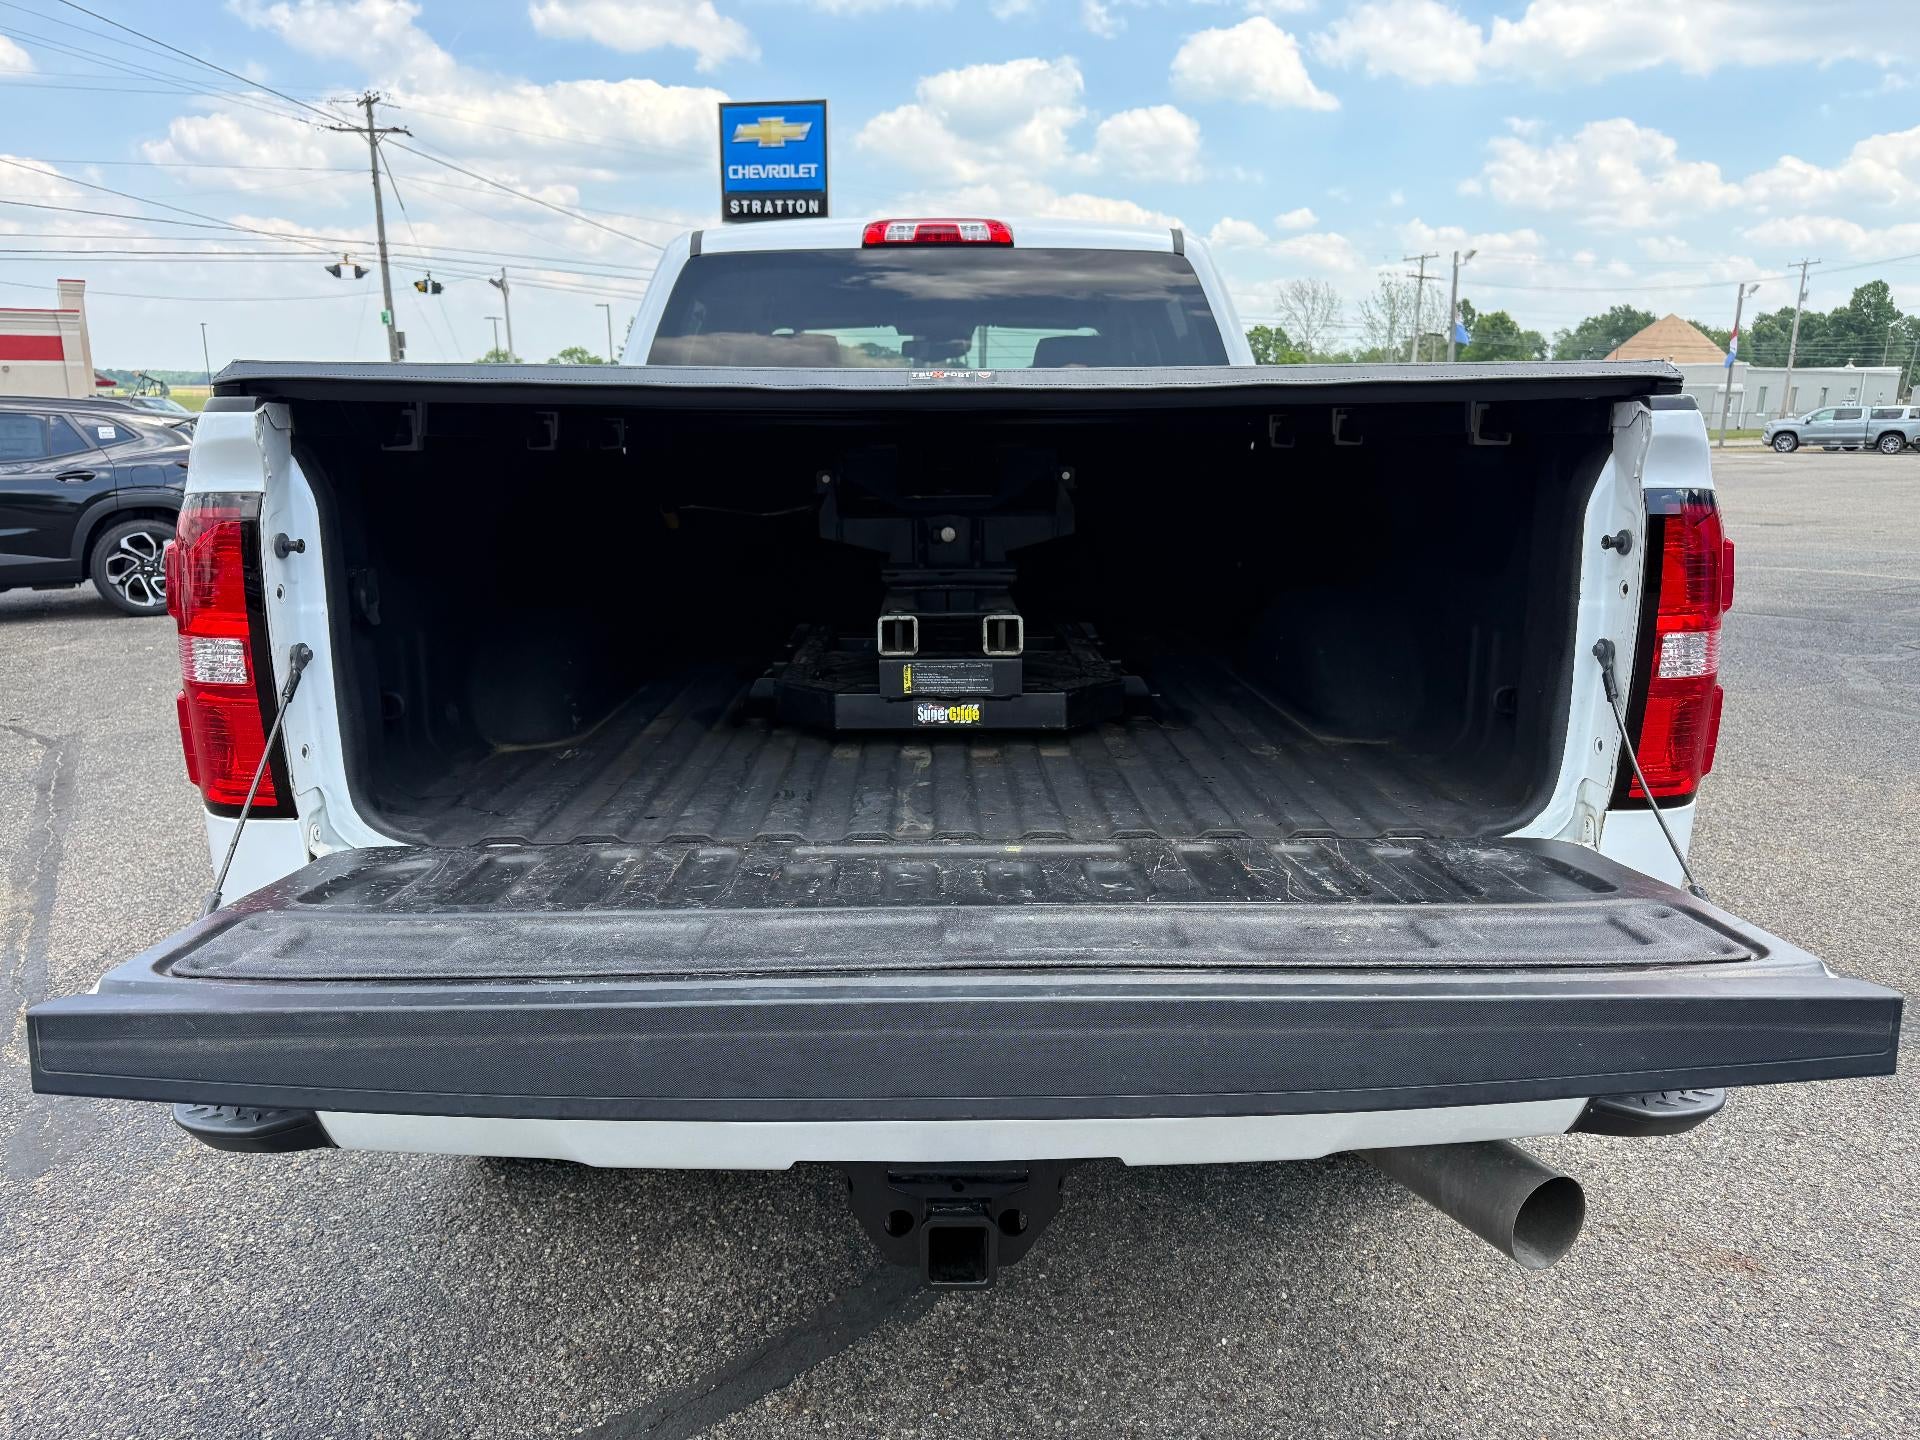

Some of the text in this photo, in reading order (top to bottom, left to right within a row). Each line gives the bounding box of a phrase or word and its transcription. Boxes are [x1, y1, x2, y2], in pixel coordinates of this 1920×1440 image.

[728, 163, 819, 179] CHEVROLET
[729, 199, 819, 214] STRATTON
[917, 706, 980, 722] SuperGlide
